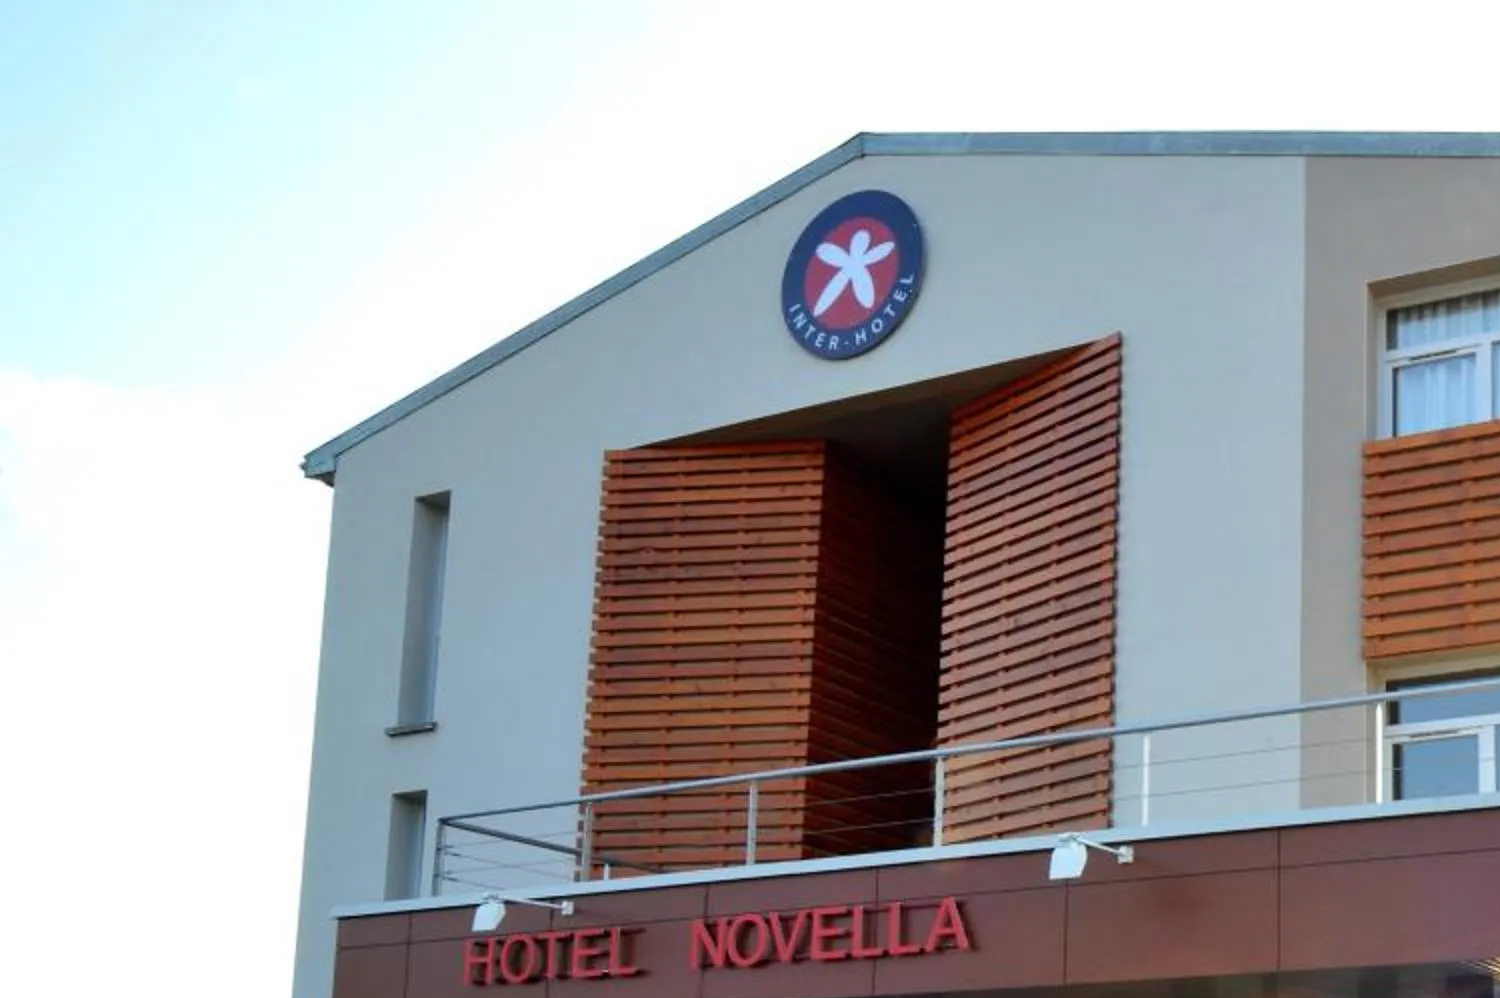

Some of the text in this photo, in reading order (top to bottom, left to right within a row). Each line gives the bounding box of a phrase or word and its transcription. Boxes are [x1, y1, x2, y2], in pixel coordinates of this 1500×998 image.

[788, 273, 914, 350] INTER-HOTEL
[463, 896, 971, 987] HOTEL NOVELLA
